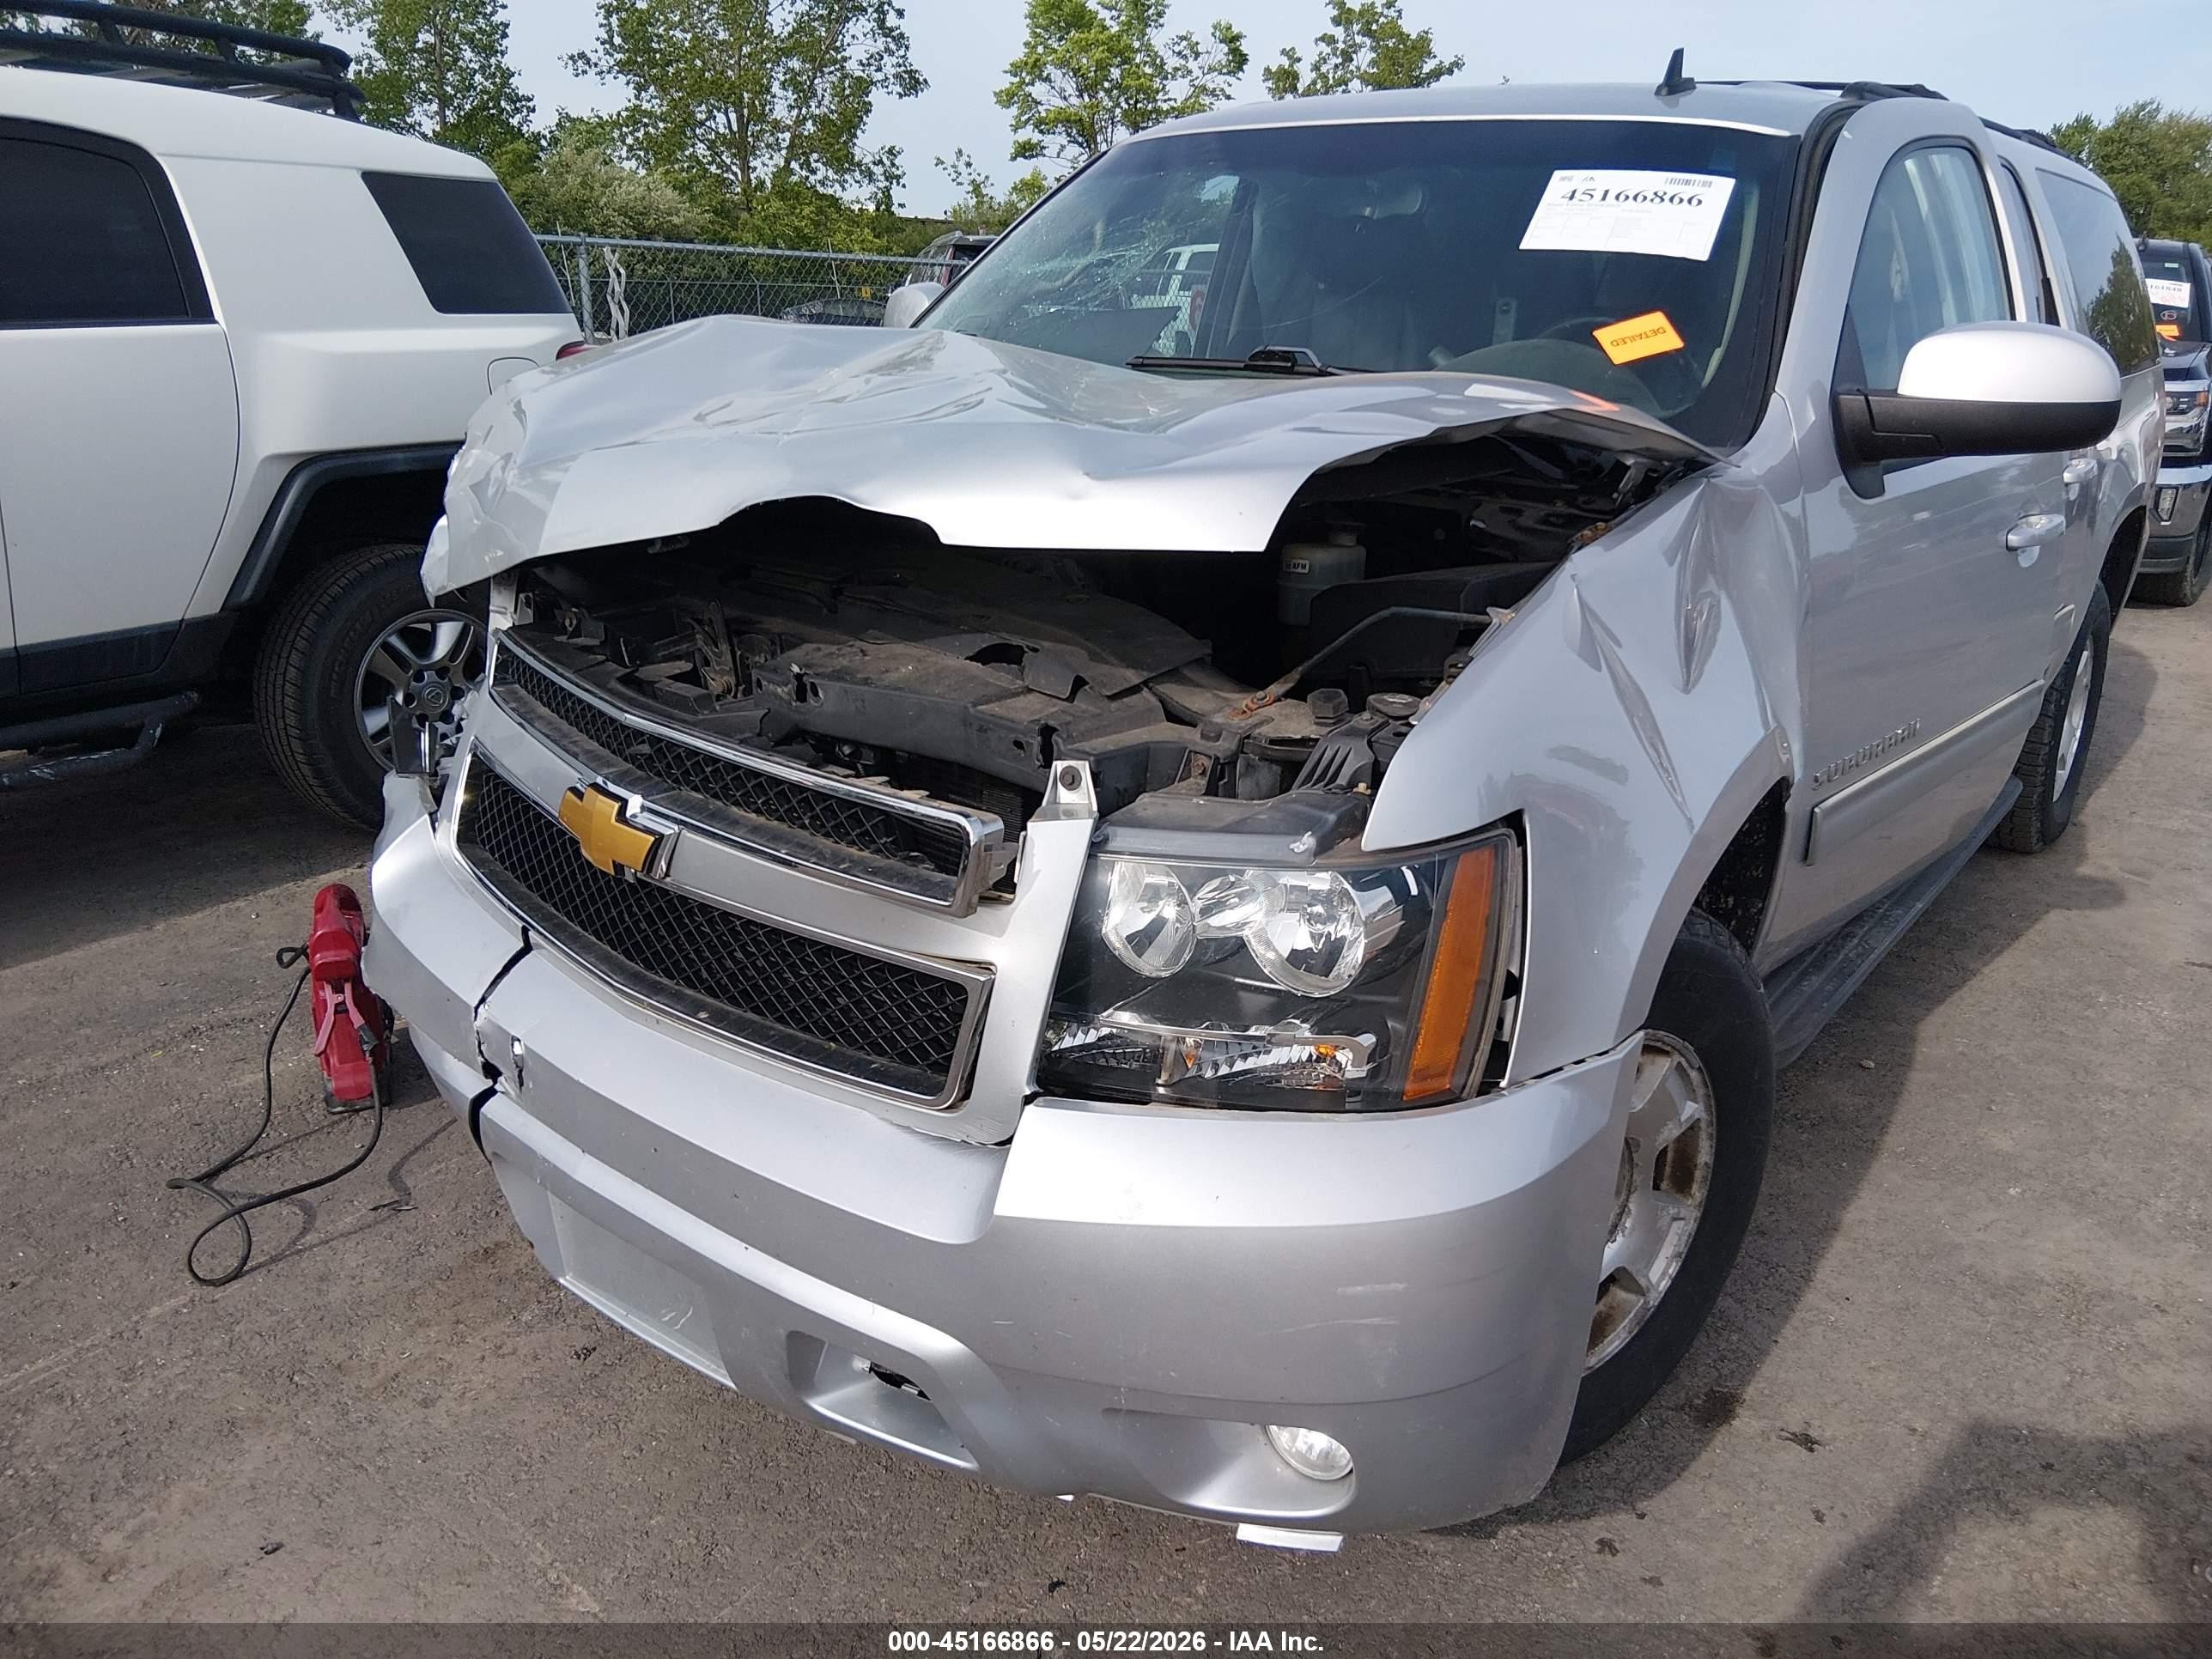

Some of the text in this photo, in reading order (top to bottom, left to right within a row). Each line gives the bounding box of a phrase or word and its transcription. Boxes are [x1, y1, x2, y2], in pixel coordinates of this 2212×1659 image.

[1561, 188, 1704, 208] 45166866
[1610, 327, 1667, 347] DETAILED
[1812, 718, 1920, 791] SUBURBAN
